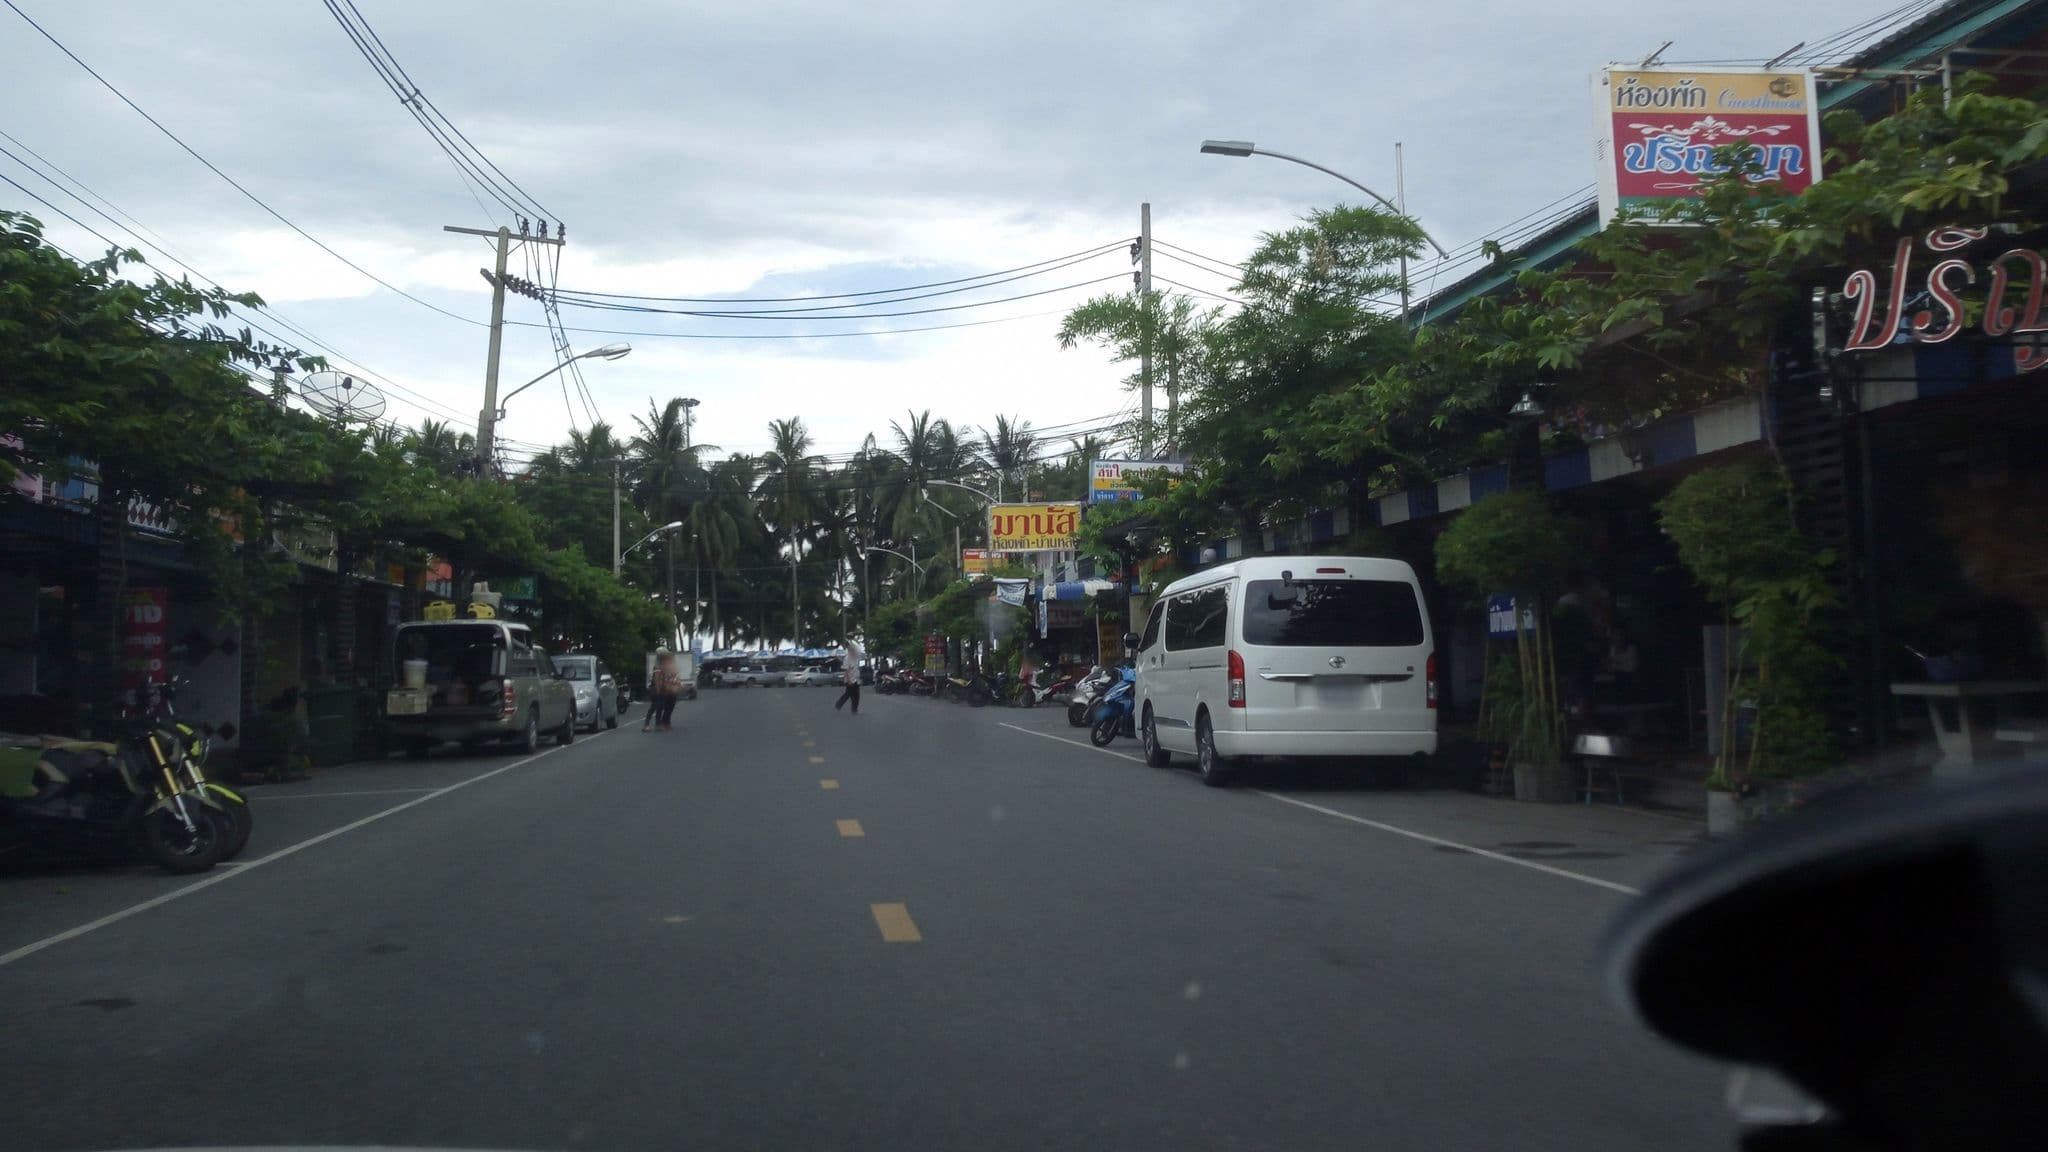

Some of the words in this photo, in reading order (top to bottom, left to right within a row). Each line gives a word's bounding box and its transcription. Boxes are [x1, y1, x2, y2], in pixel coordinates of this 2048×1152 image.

[1616, 77, 1706, 108] ห้องพัก
[992, 506, 1077, 535] มานัส
